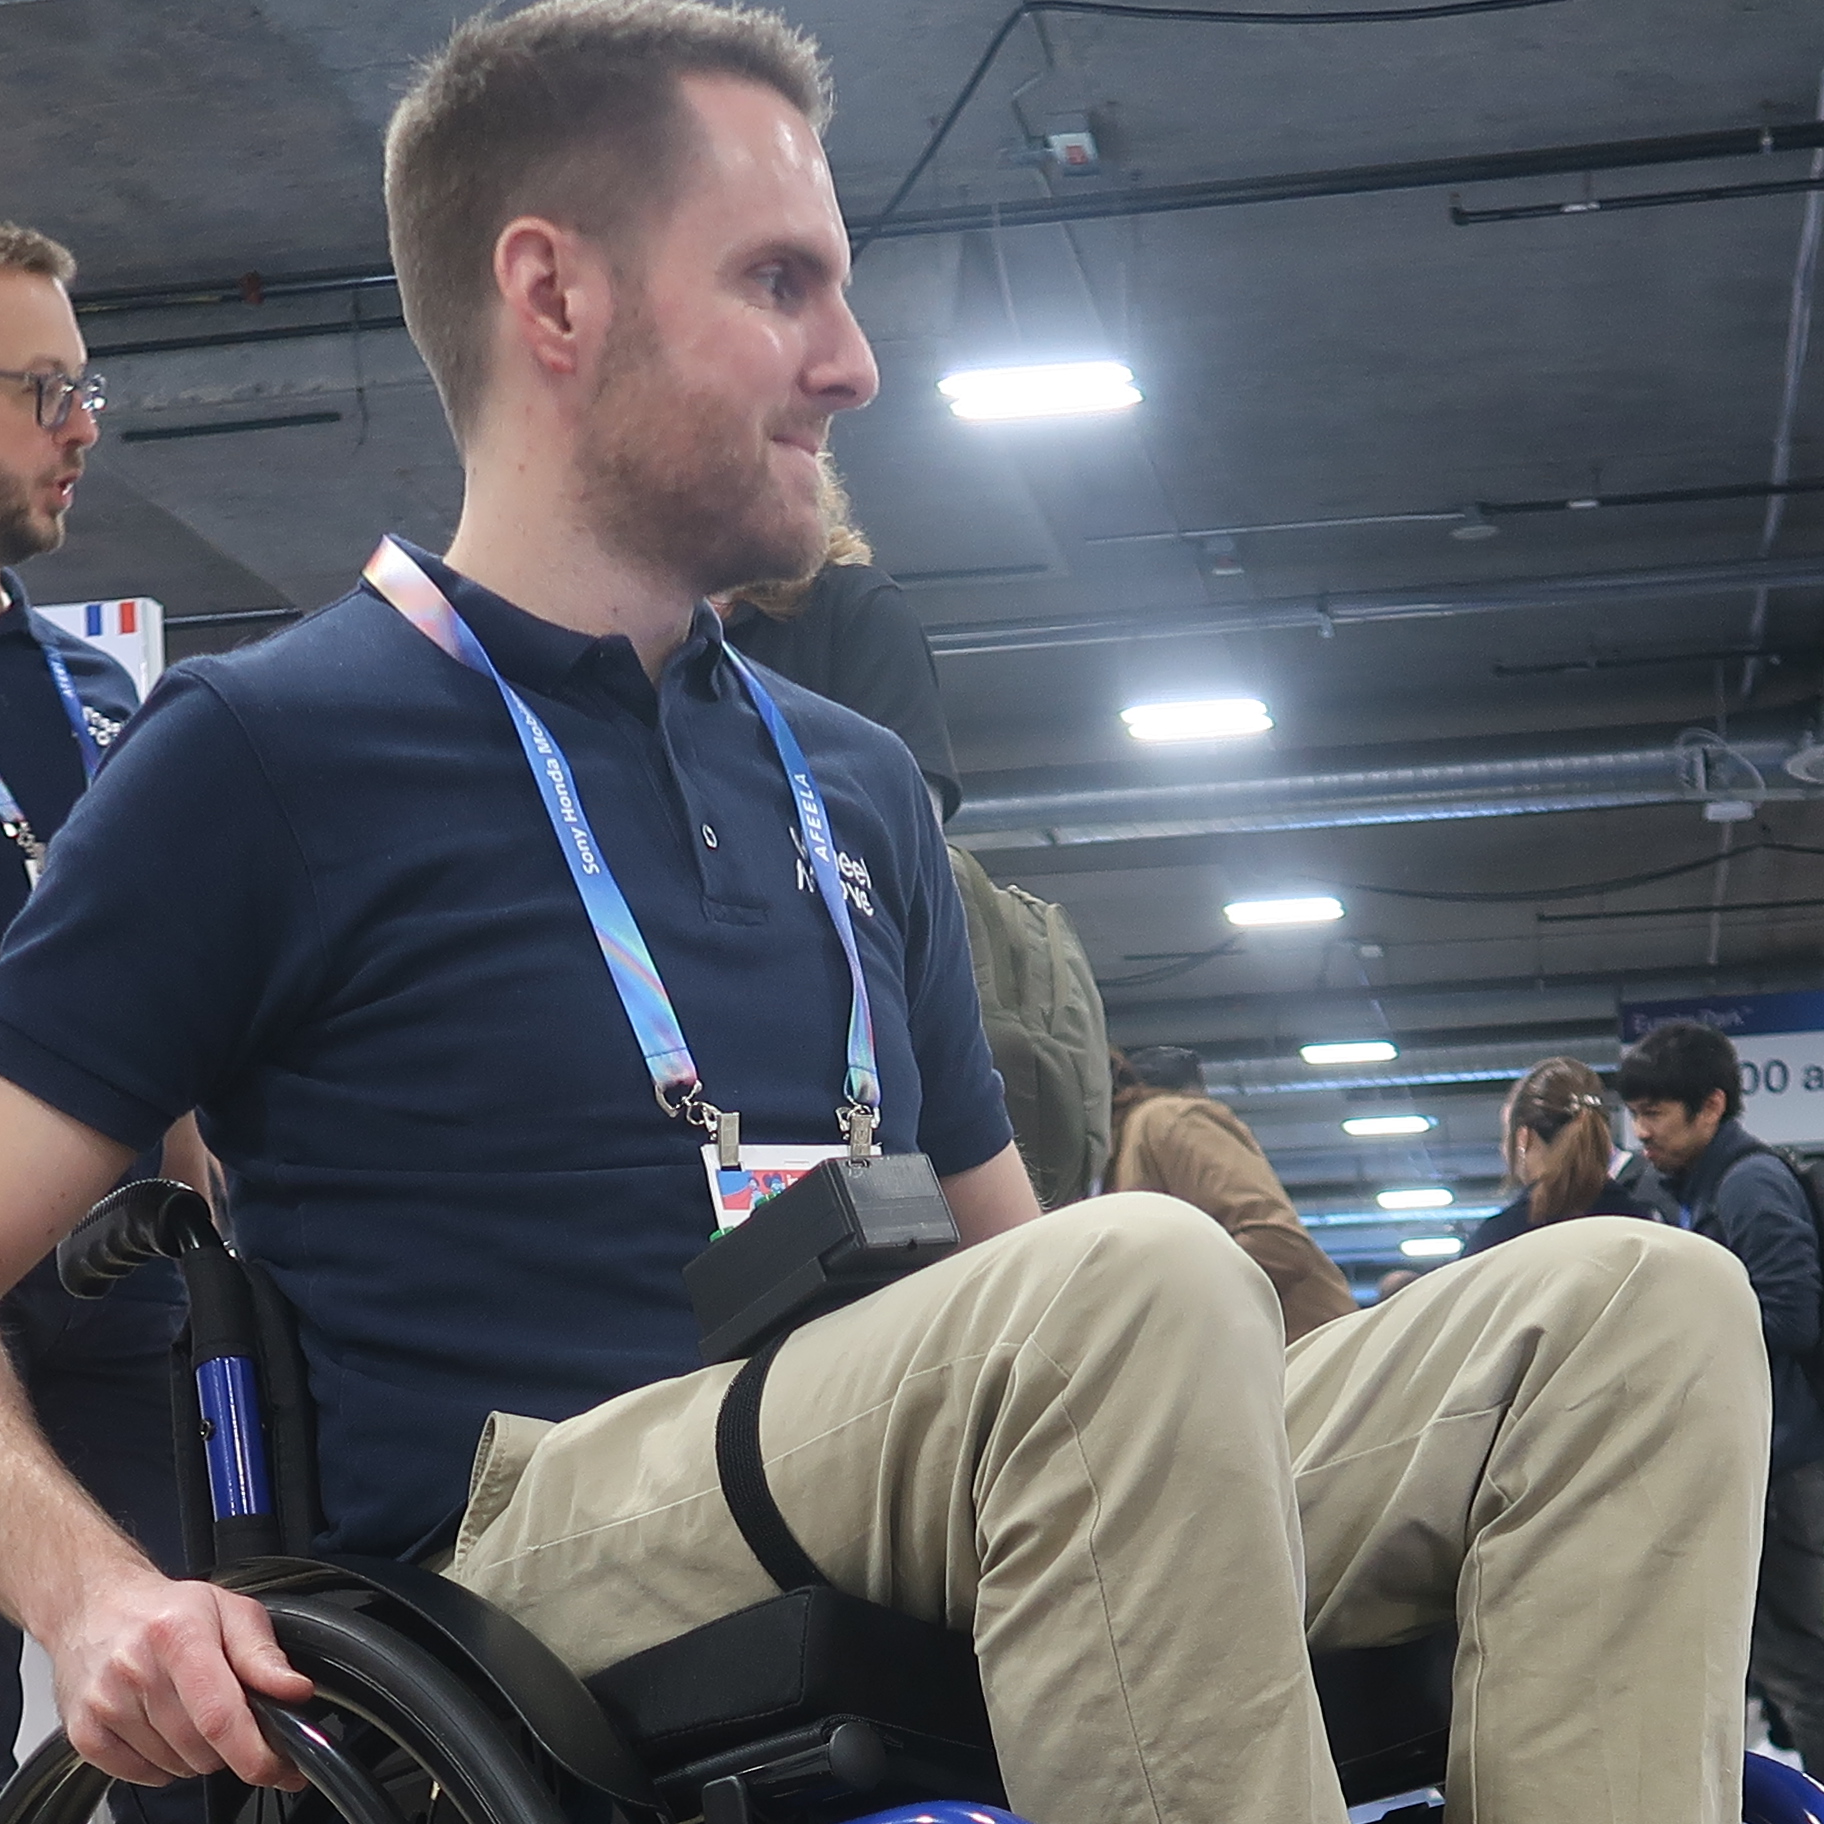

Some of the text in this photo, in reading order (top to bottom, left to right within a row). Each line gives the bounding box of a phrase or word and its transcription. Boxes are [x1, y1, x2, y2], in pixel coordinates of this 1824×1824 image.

[546, 757, 577, 823] Honda
[793, 773, 829, 863] AFEELA
[571, 826, 600, 876] Sony
